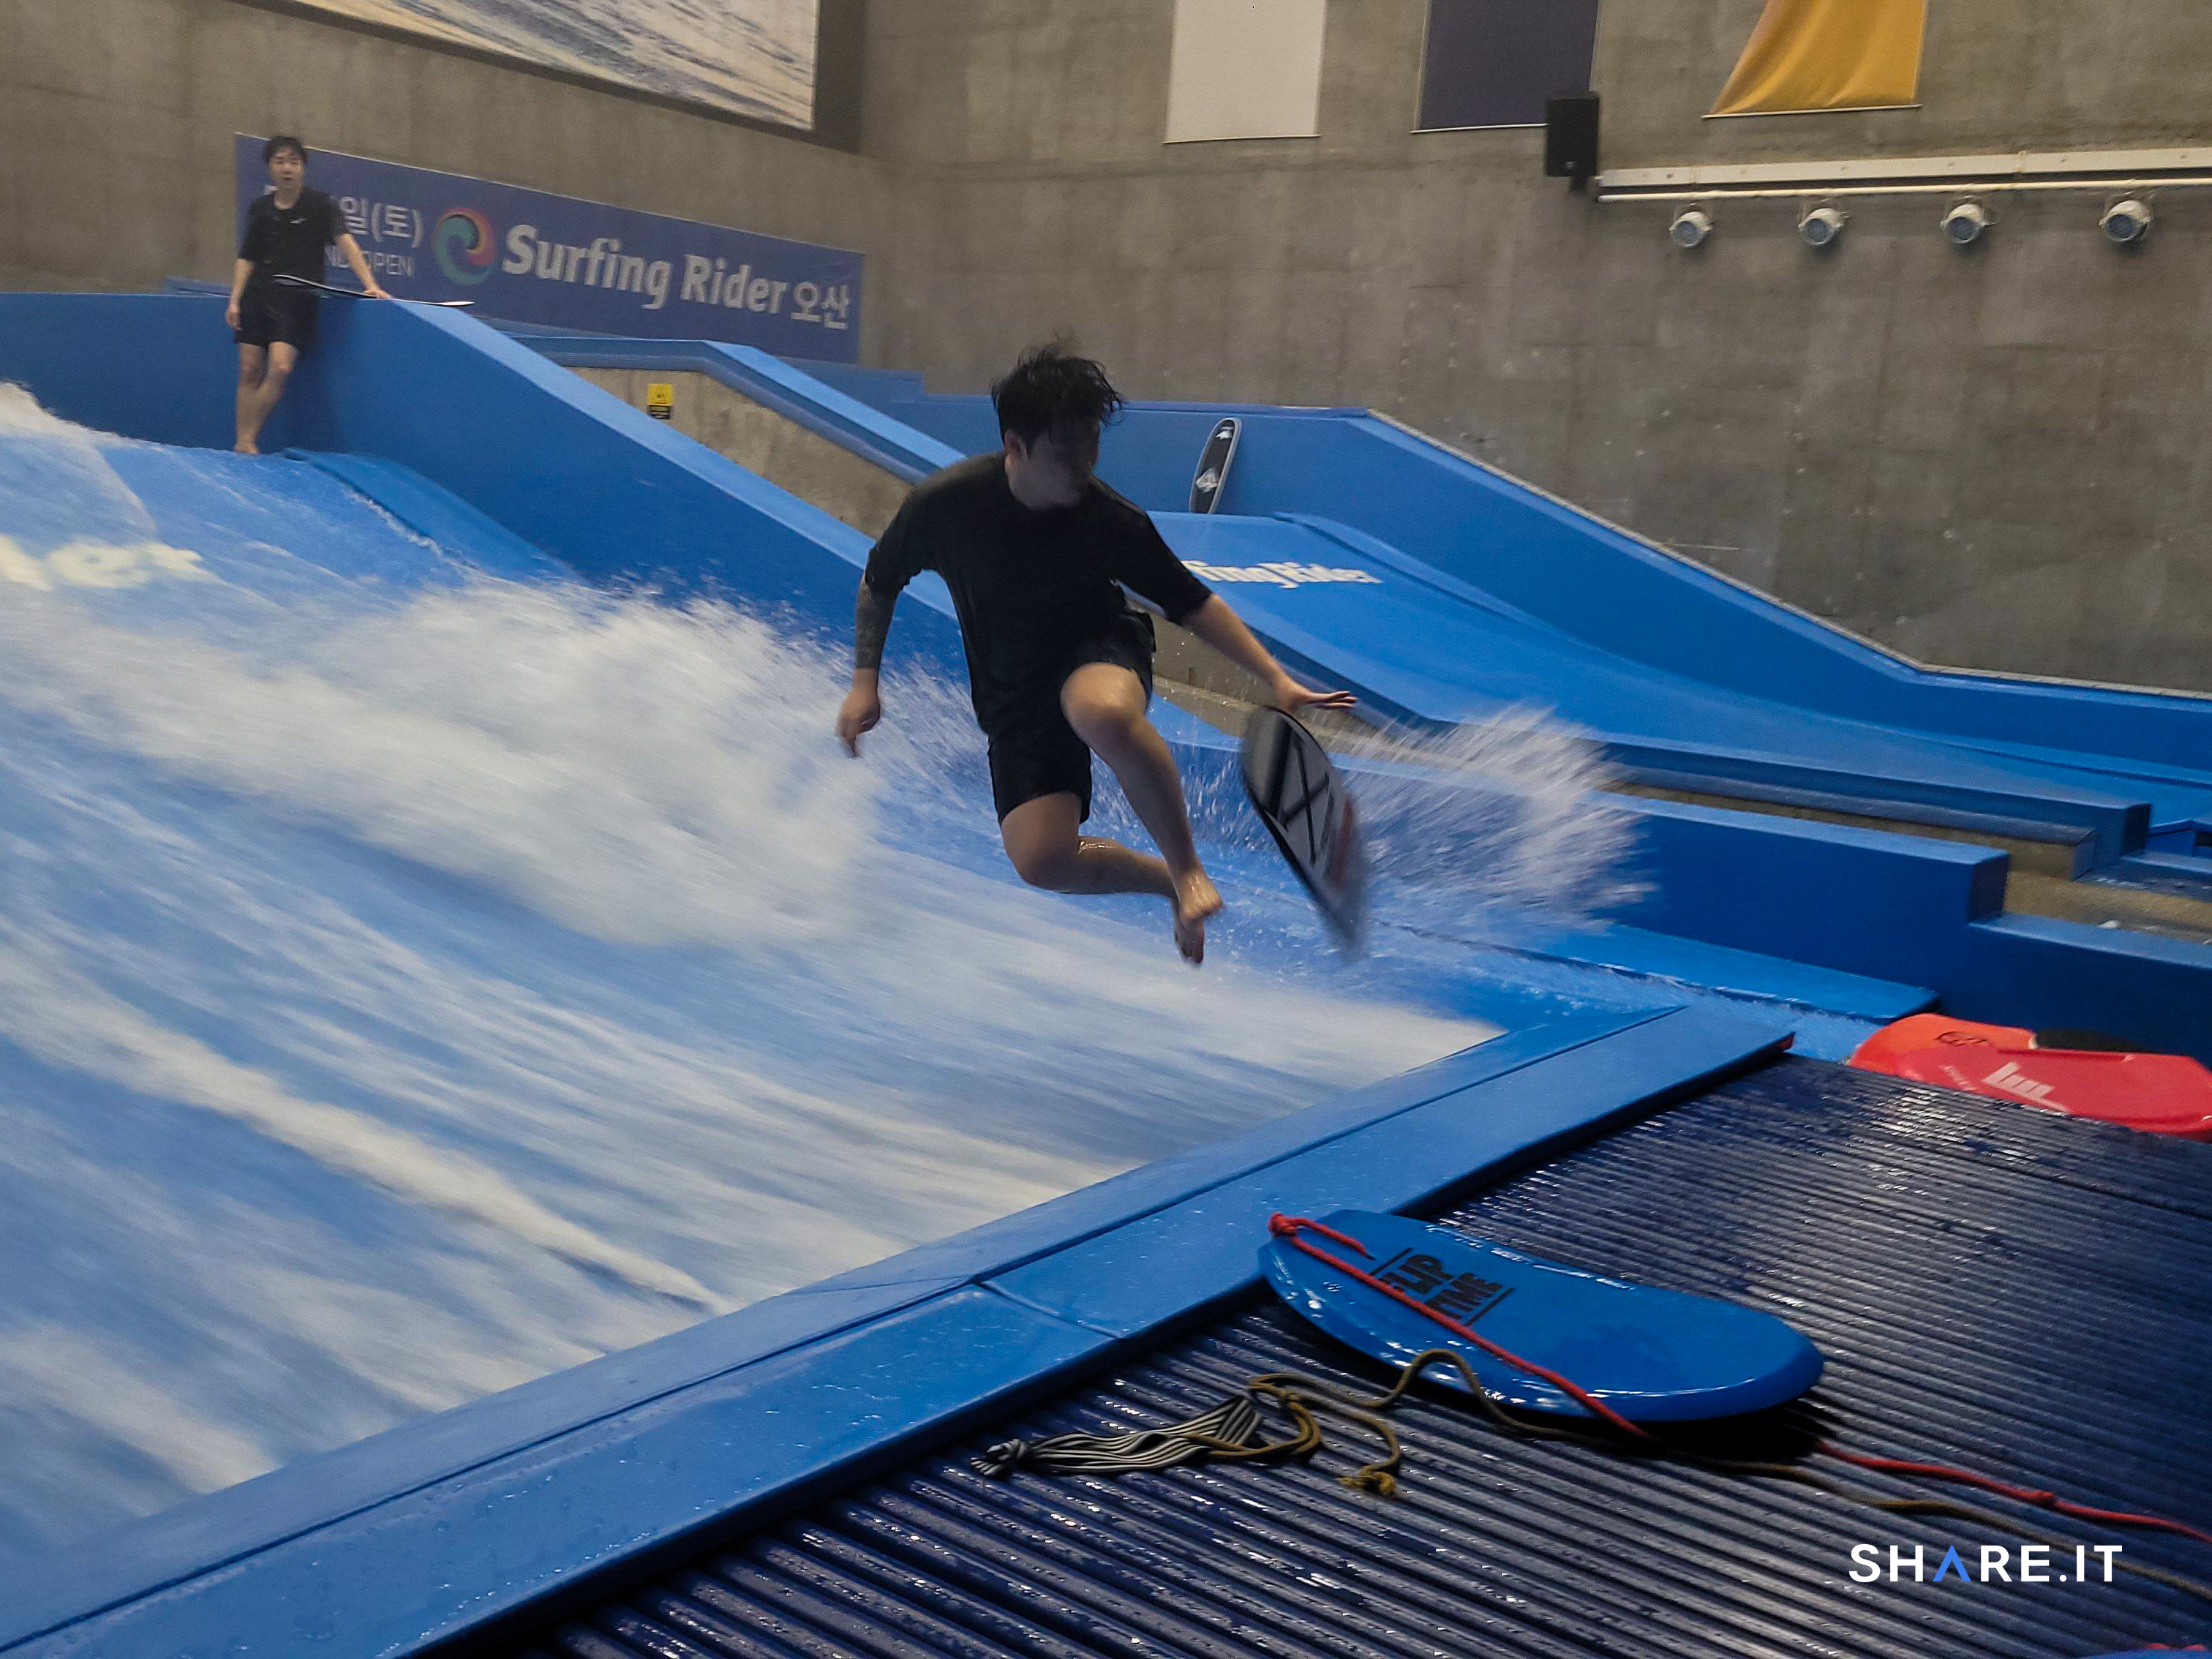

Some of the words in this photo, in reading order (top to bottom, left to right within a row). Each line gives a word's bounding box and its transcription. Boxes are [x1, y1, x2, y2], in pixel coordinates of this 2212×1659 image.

[339, 196, 424, 248] 일(토)
[502, 224, 672, 310] Surfing
[680, 254, 789, 315] Rider
[791, 281, 852, 330] 오산
